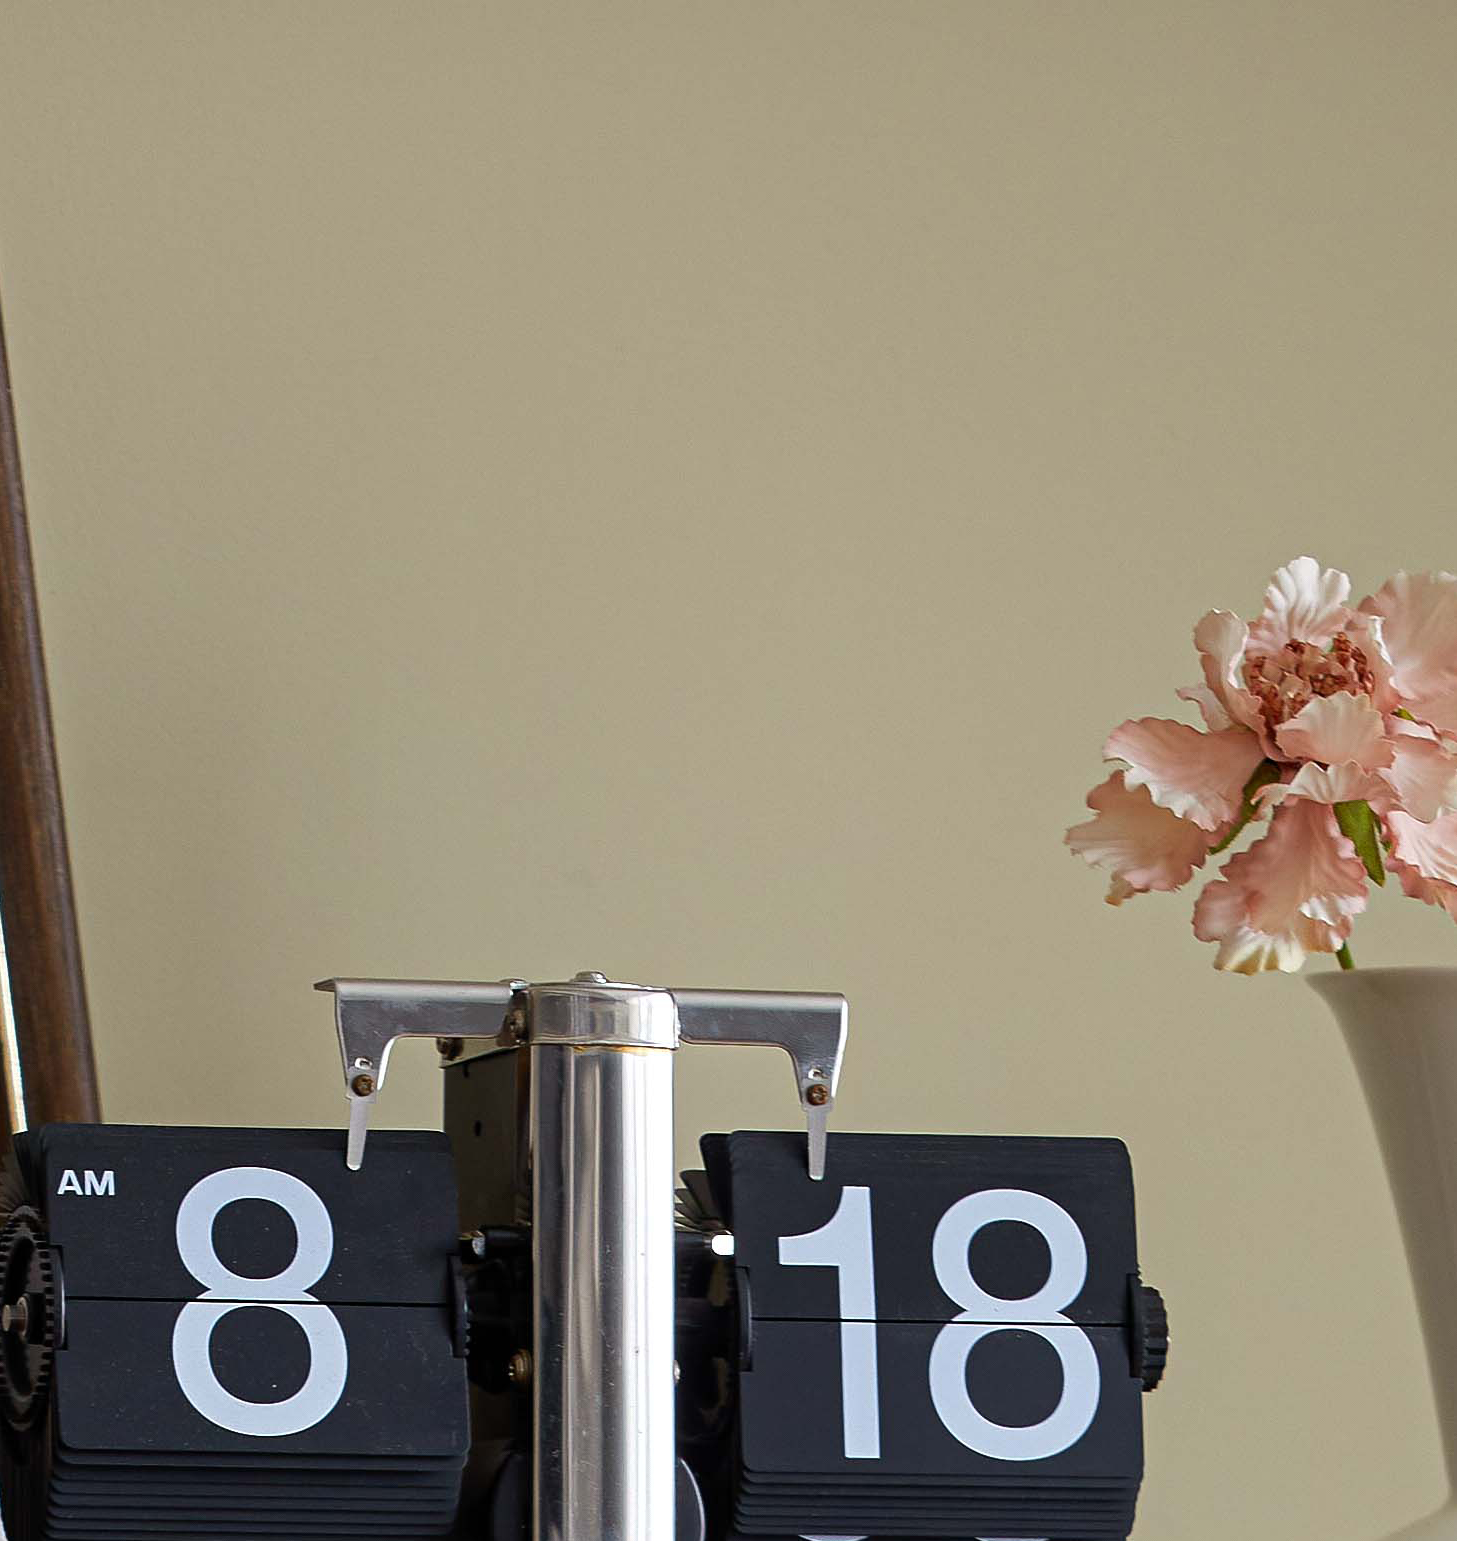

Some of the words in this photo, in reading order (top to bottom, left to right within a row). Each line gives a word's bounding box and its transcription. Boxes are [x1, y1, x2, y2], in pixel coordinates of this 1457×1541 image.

[56, 1169, 116, 1198] AM
[171, 1165, 349, 1438] 8
[776, 1184, 1102, 1462] 18
